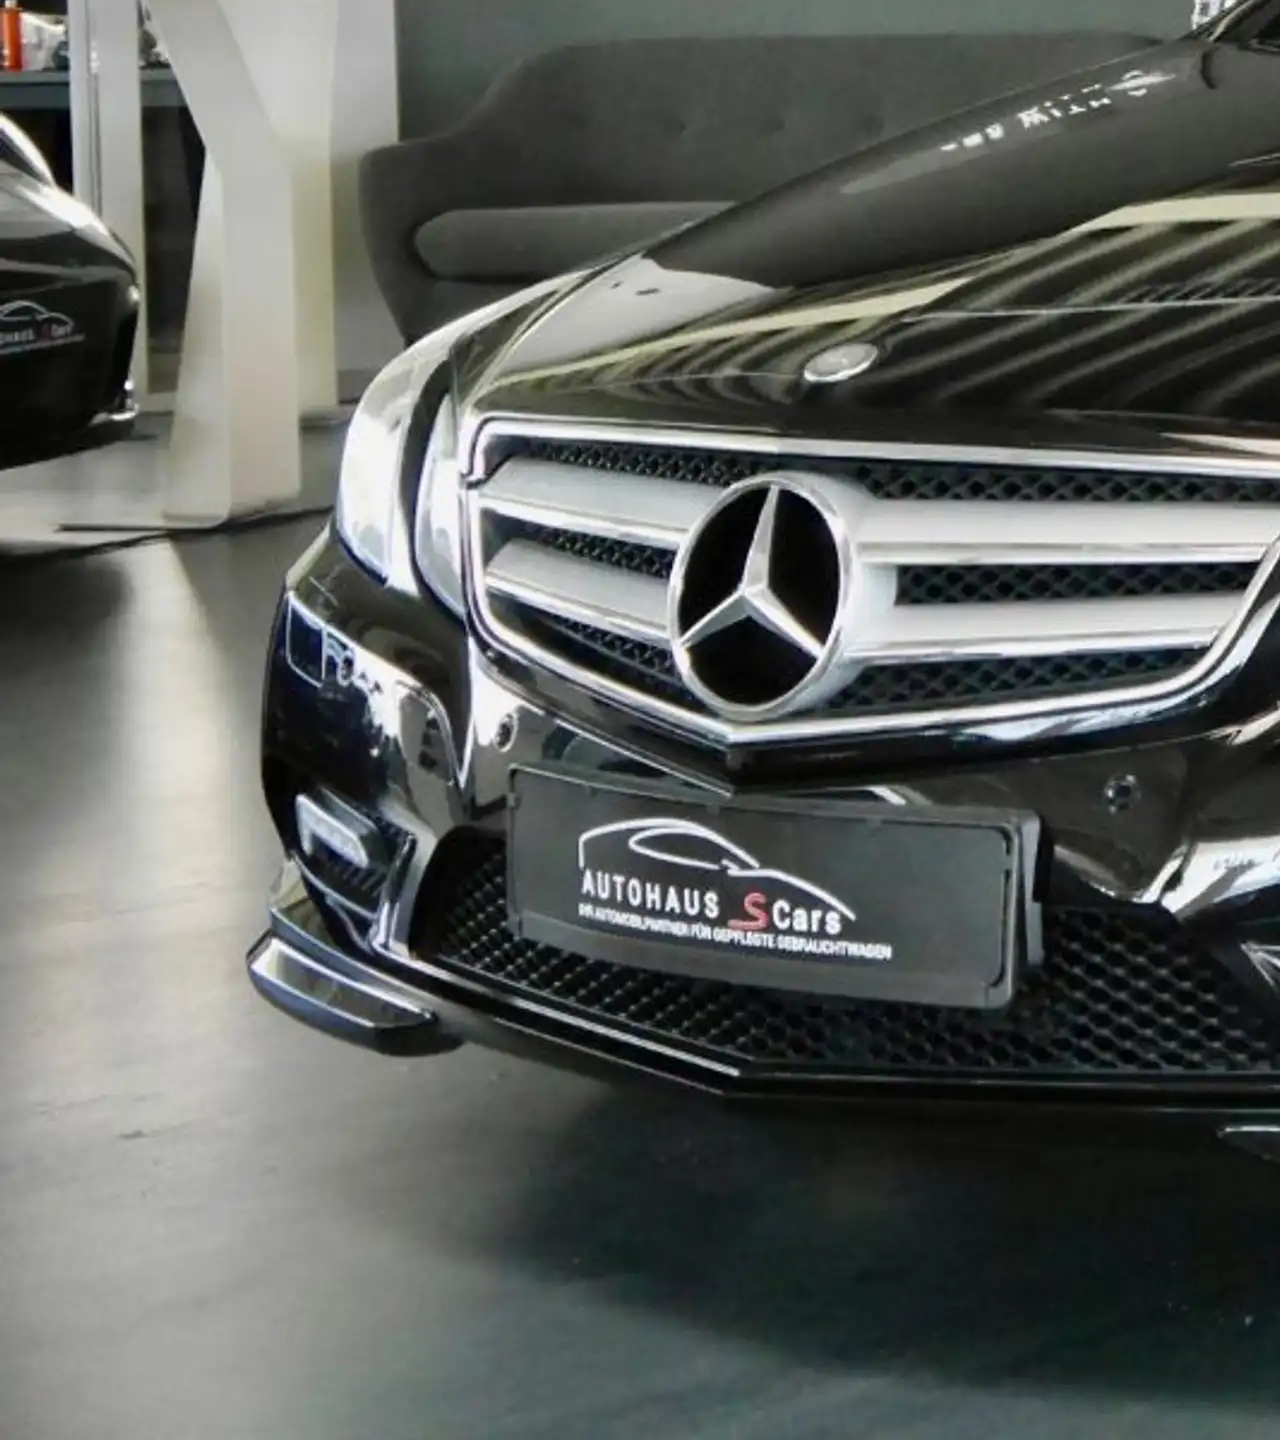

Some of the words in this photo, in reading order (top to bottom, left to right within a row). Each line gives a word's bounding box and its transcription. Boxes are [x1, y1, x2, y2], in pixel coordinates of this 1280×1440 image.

[581, 868, 720, 918] AUTOHAUS
[728, 891, 769, 931] S
[771, 898, 842, 936] Cars
